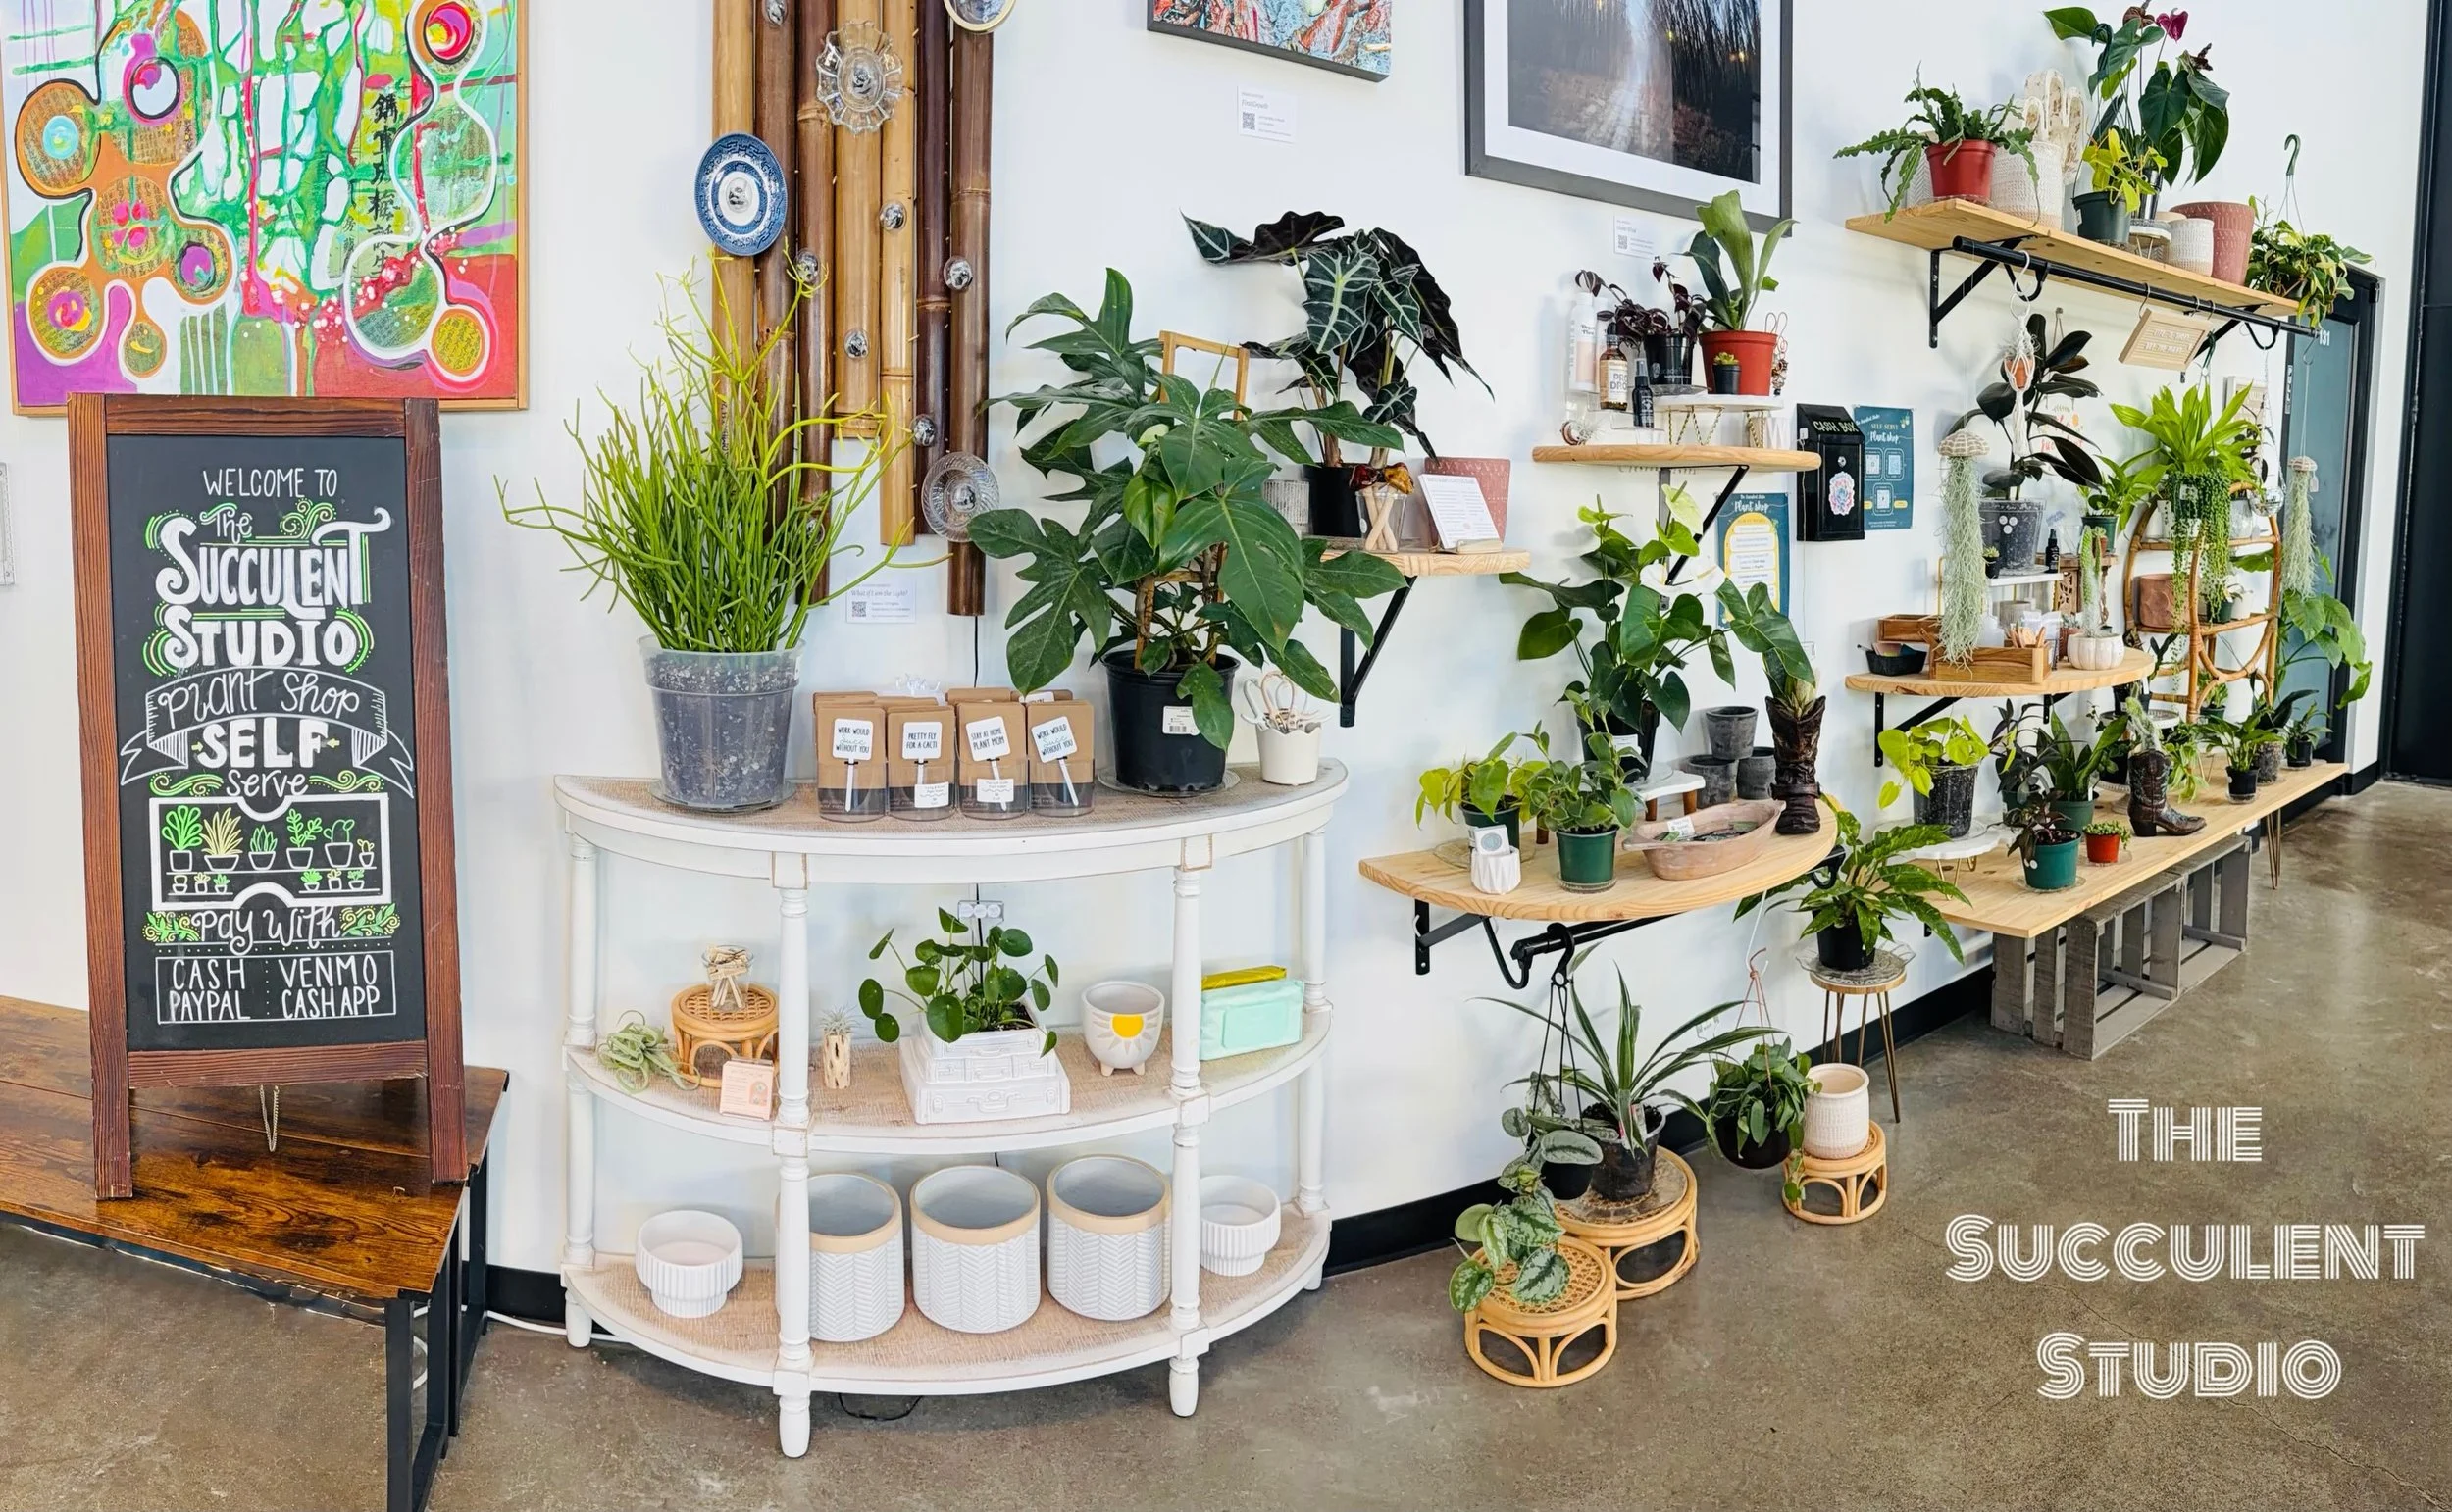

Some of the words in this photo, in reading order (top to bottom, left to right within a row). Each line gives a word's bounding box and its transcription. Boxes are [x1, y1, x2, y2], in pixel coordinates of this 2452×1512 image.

[2319, 329, 2330, 346] 131
[1813, 420, 1840, 432] CASH
[1840, 421, 1859, 433] BOX
[203, 467, 305, 497] WELCOME
[314, 469, 337, 497] TO
[199, 507, 253, 545] The
[852, 728, 870, 736] WOULD
[971, 731, 982, 740] STAY
[990, 727, 1002, 736] HOME
[1036, 731, 1050, 739] WORK
[1050, 724, 1067, 734] WOULD
[196, 717, 329, 769] SELF
[859, 745, 869, 754] YOU
[972, 738, 990, 751] PLANT
[992, 735, 1005, 747] MOM
[1042, 744, 1063, 756] WITHOUT
[1064, 740, 1073, 749] YOU
[172, 959, 245, 990] CASH
[278, 954, 378, 988] VENMO
[169, 989, 251, 1022] PAYPAL
